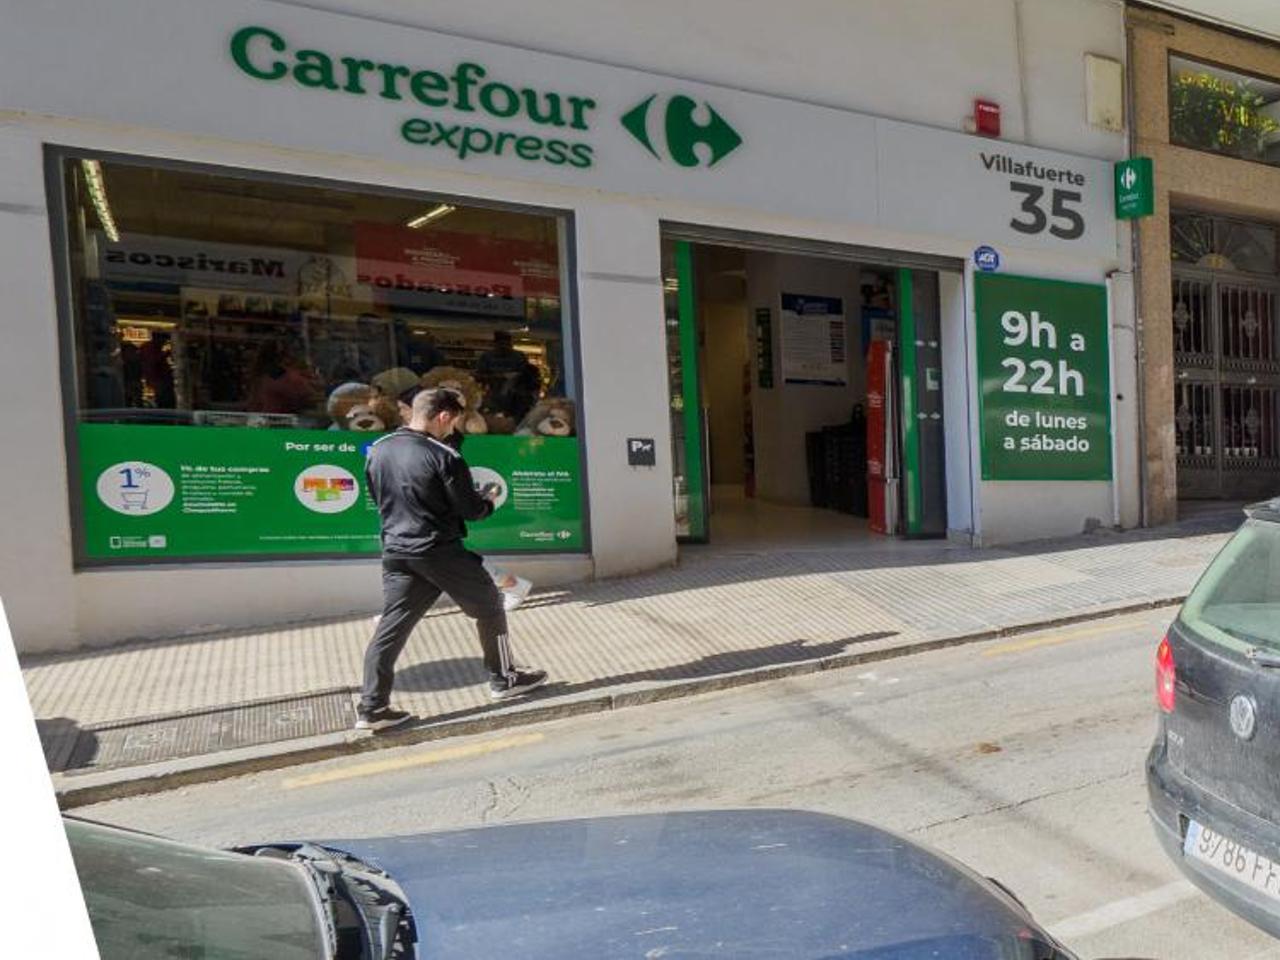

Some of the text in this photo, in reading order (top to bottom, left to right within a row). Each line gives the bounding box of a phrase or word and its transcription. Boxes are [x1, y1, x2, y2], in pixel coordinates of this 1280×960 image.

[230, 26, 597, 130] Carrefour
[400, 112, 594, 169] express
[980, 152, 1085, 186] Villafuerte
[1009, 181, 1085, 241] 35
[1001, 310, 1085, 352] 9h a
[1001, 358, 1084, 396] 22h
[1005, 410, 1087, 429] de lunes
[285, 442, 355, 452] Por ser de
[1003, 432, 1090, 453] a sábado
